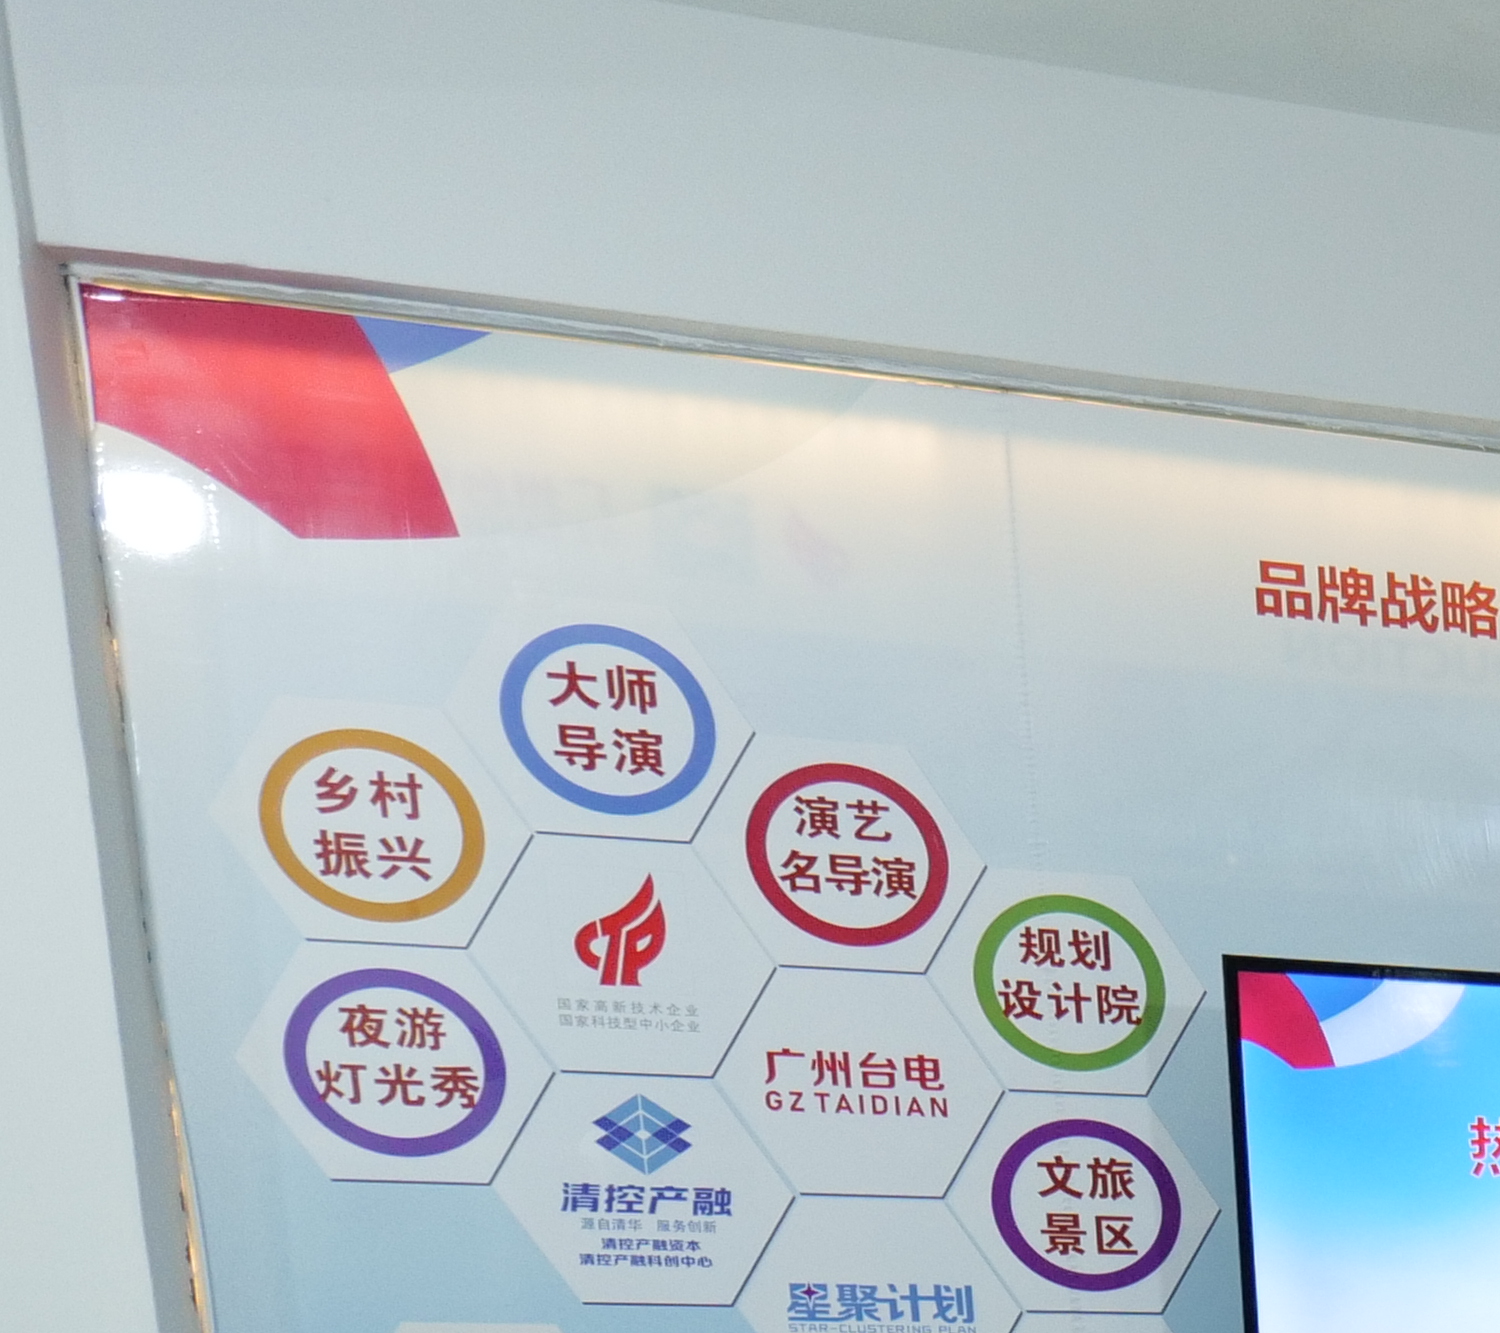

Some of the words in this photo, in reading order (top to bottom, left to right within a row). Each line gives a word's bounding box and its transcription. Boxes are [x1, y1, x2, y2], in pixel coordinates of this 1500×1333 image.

[547, 661, 659, 715] 大师
[554, 724, 666, 778] 导演
[314, 767, 423, 820] 乡村
[794, 796, 892, 843] 演艺
[314, 830, 432, 881] 振兴
[780, 850, 918, 899] 名导演
[1019, 927, 1113, 971] 规划
[998, 980, 1142, 1026] 设计院
[338, 1004, 447, 1050] 夜游
[316, 1061, 481, 1109] 灯光秀
[765, 1048, 945, 1091] 广州台电
[765, 1091, 805, 1113] GZ
[815, 1093, 949, 1118] TAIDIAN
[561, 1182, 733, 1217] 清控产融
[1037, 1156, 1136, 1200] 文旅
[1040, 1213, 1138, 1257] 景区
[787, 1282, 975, 1324] 星聚计划
